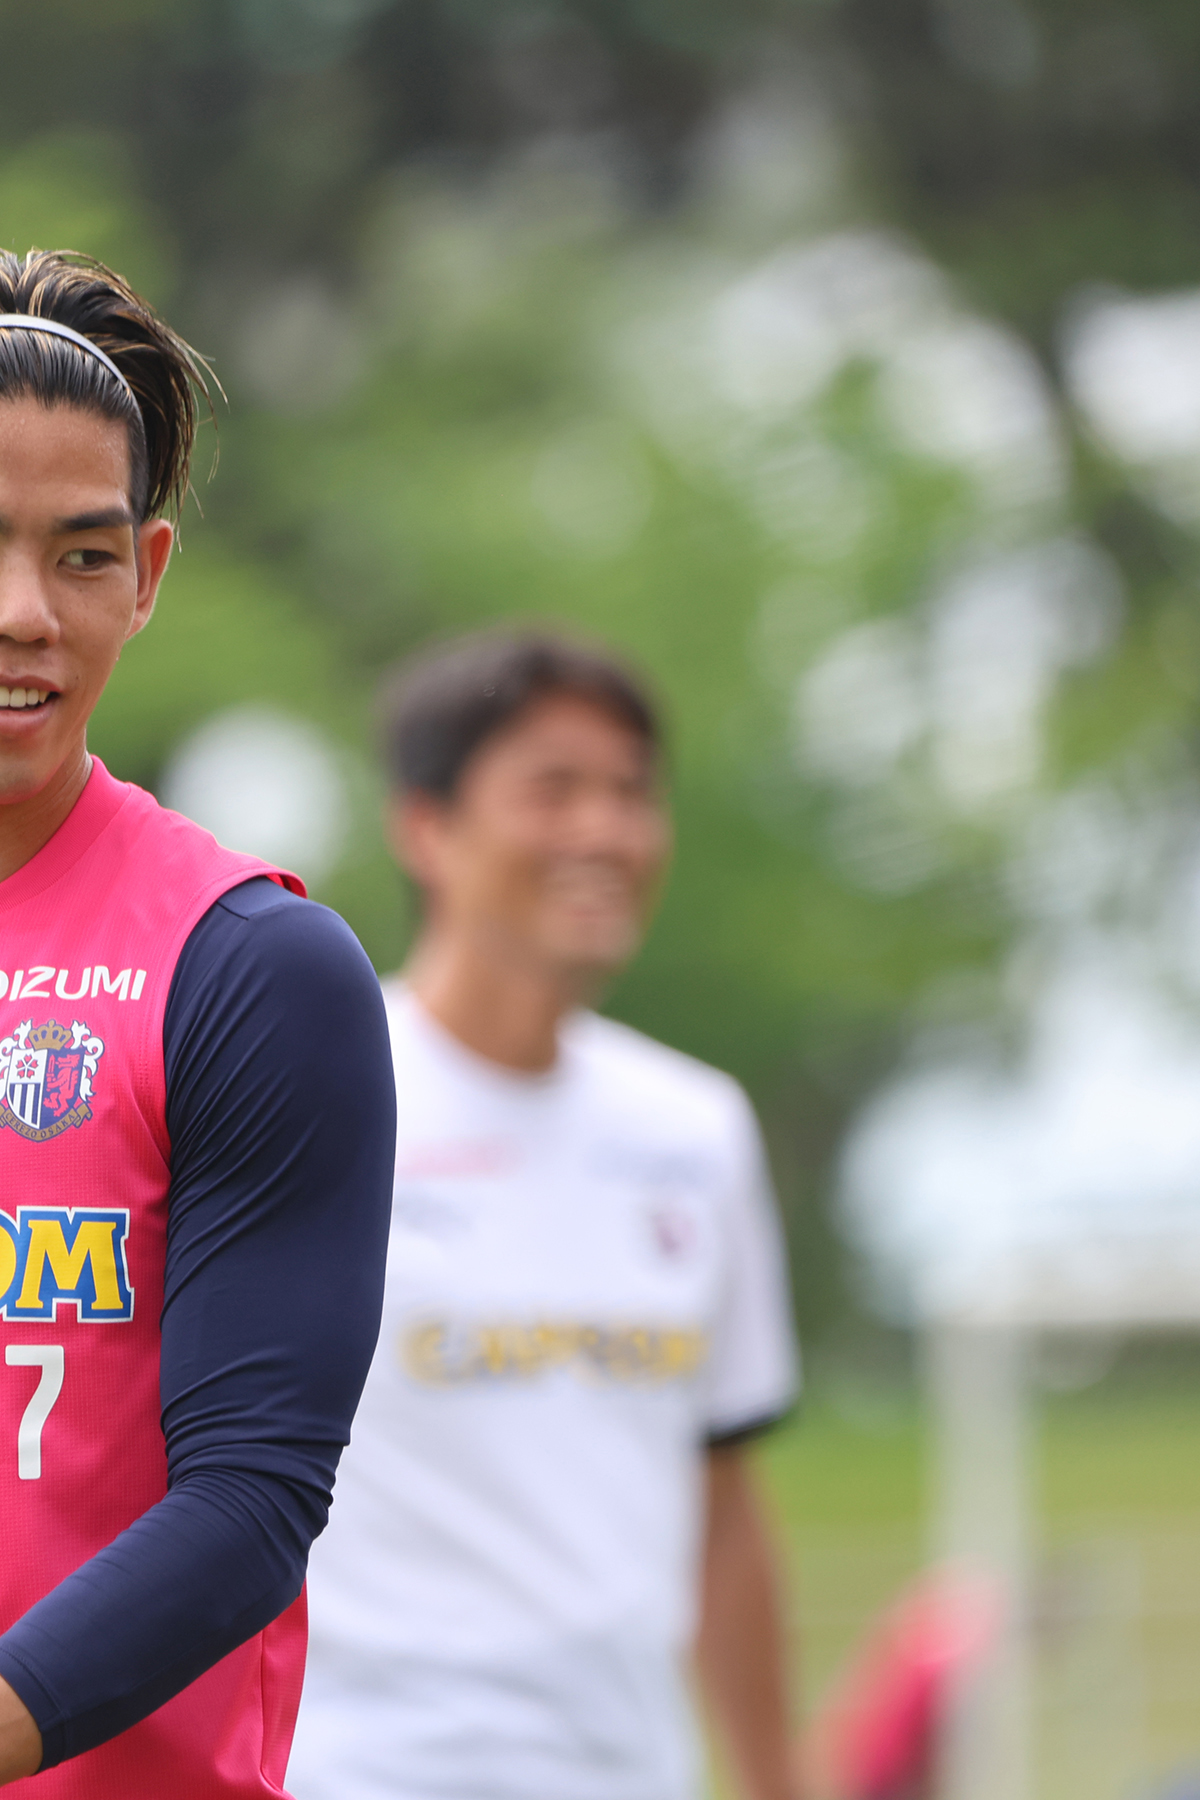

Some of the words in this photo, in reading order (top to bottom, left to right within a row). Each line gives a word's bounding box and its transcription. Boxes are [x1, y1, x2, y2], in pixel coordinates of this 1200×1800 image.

[5, 1113, 37, 1138] CEREZO
[40, 1115, 75, 1139] OSAKA
[5, 1345, 65, 1480] 7
